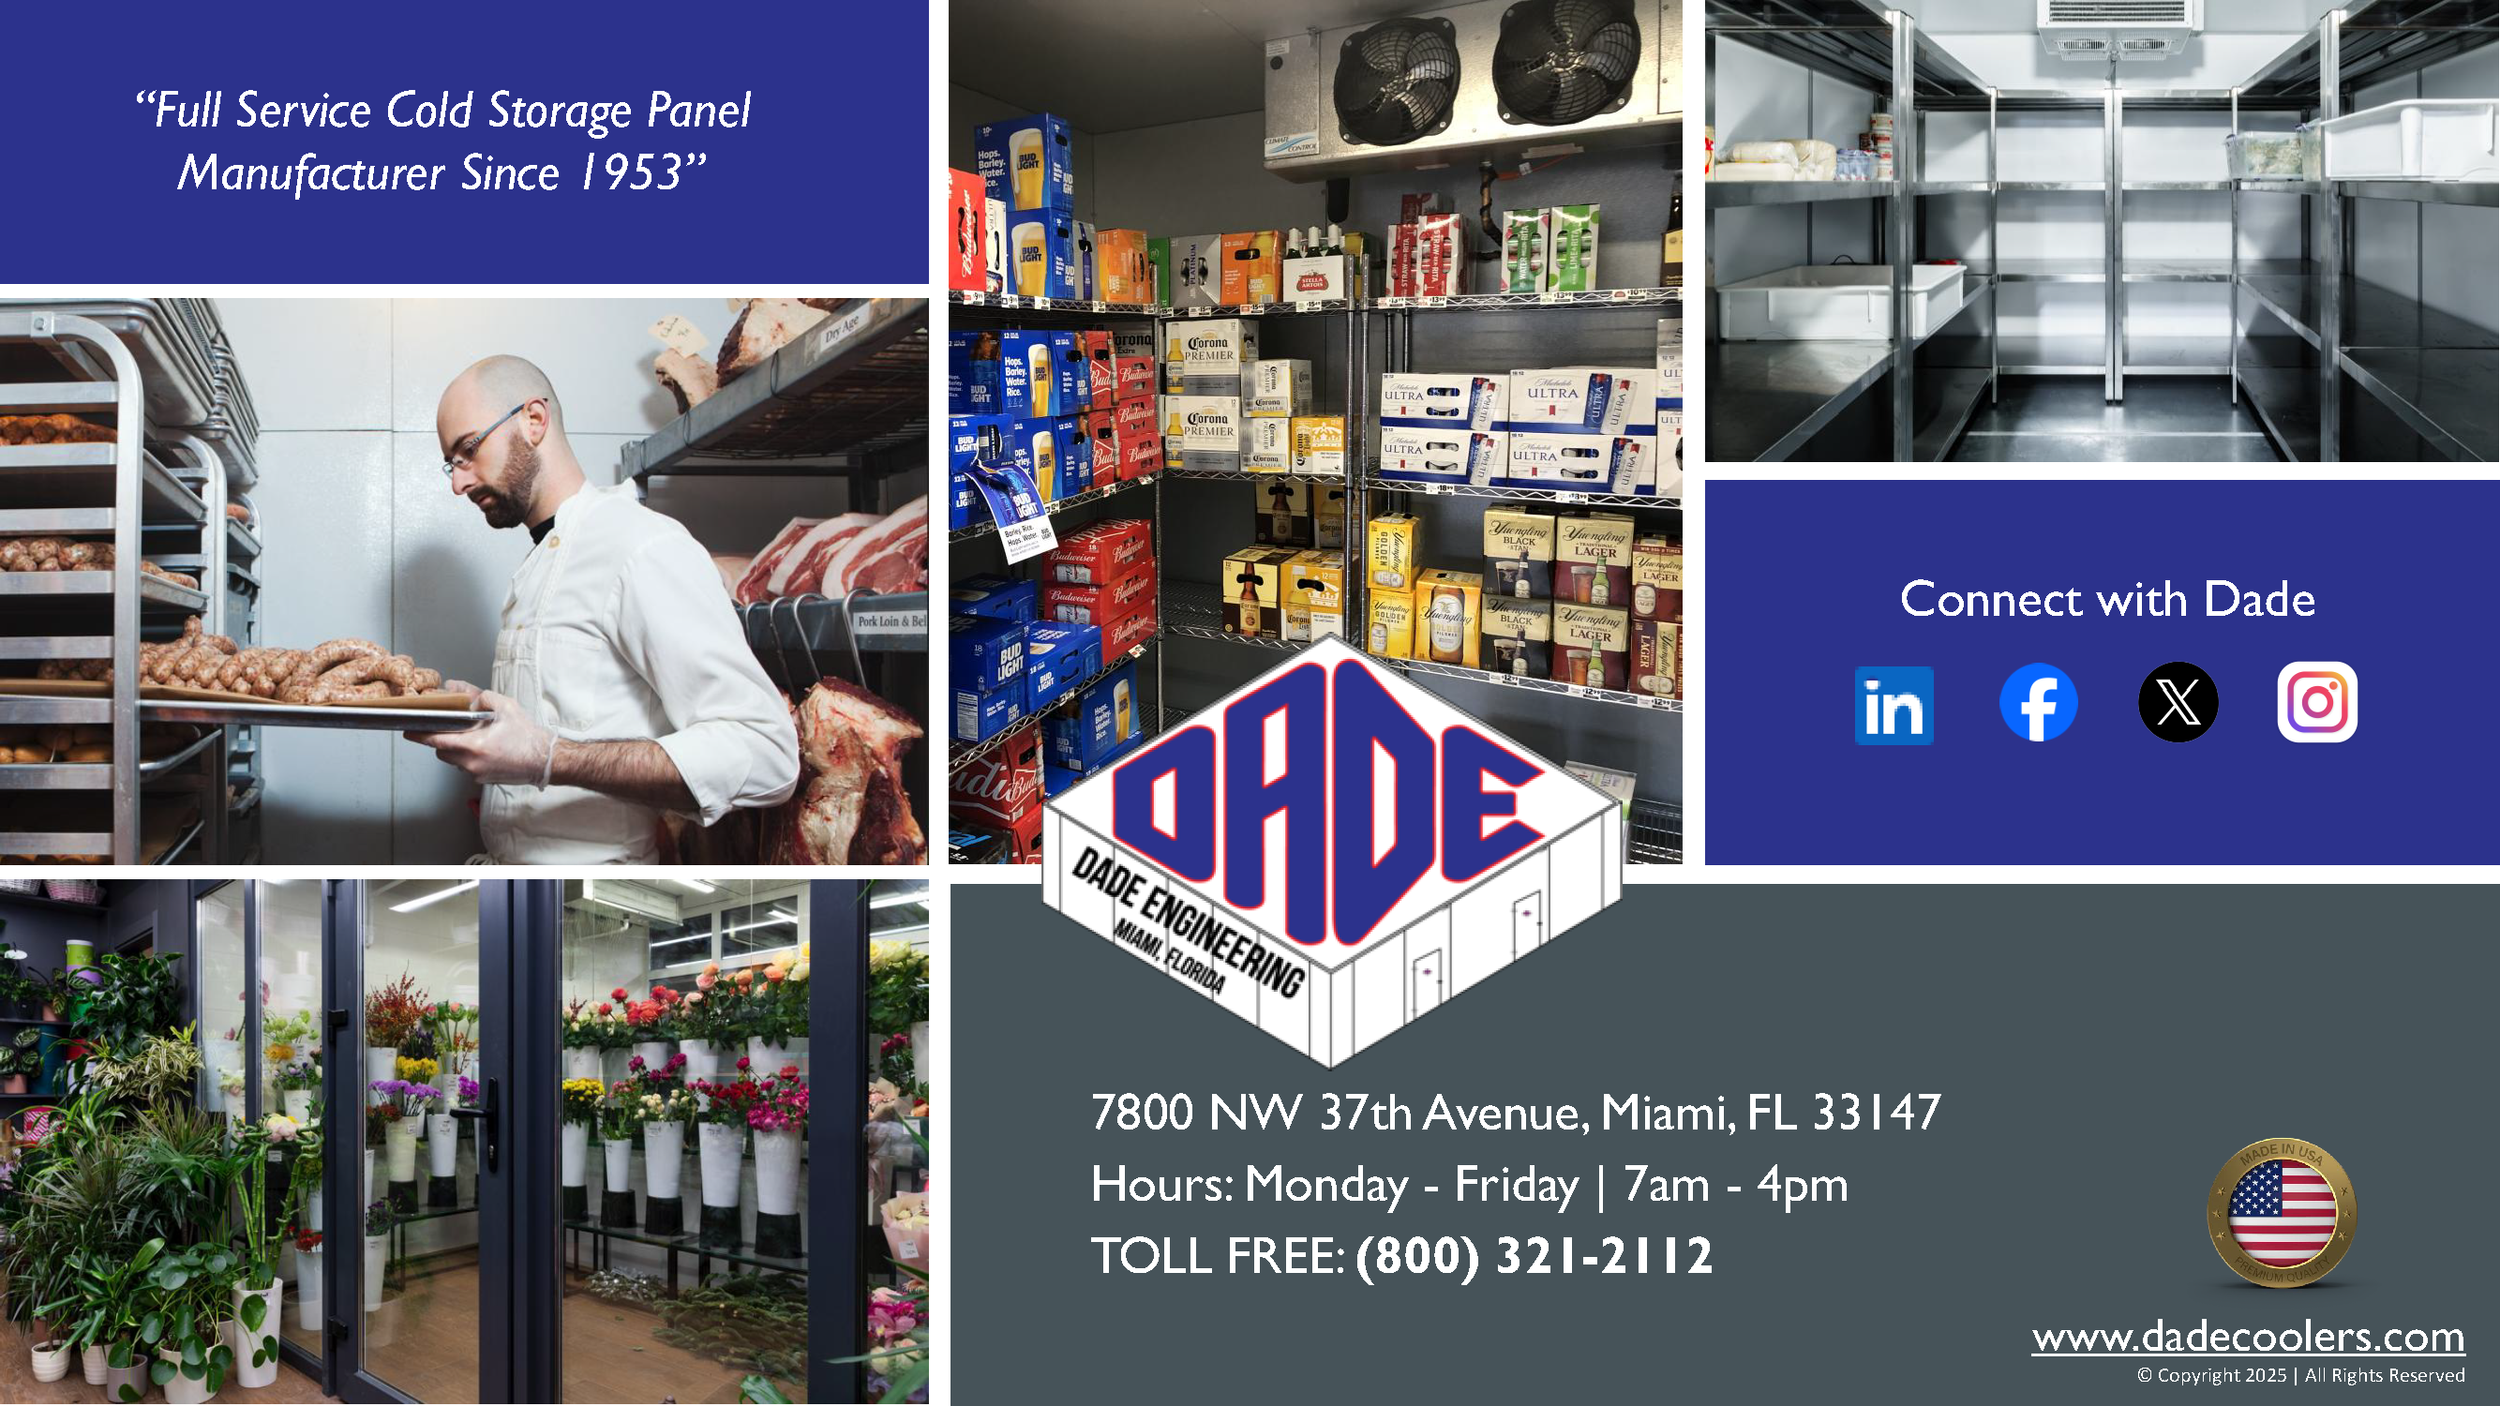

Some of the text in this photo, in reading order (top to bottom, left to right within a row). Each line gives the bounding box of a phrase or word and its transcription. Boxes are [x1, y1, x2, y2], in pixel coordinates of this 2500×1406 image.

[978, 158, 1006, 169] Barley.
[826, 316, 859, 343] Dry Age
[1188, 337, 1228, 351] Corona
[1005, 357, 1023, 367] Hops.
[1185, 351, 1234, 360] PREMIER
[1005, 367, 1027, 377] Barley.
[1270, 366, 1278, 390] Corona
[1006, 377, 1027, 387] Water.
[1006, 387, 1022, 397] Rice.
[1385, 391, 1424, 401] ULTRA
[1528, 388, 1579, 399] ULTRA
[1256, 399, 1281, 407] Corona
[1479, 394, 1492, 422] ULTRA
[1592, 386, 1604, 418] ULTRA
[1118, 407, 1155, 424] Budweiser
[1610, 393, 1627, 426] ULTRA
[1187, 412, 1228, 427] Corona
[1184, 426, 1235, 436] PREMIER
[958, 436, 974, 445] BUD
[1127, 444, 1163, 463] Budweiser
[1297, 433, 1306, 466] Corona
[1384, 445, 1423, 455] ULTRA
[1513, 451, 1558, 461] ULTRA
[1253, 455, 1279, 463] Corona
[1478, 450, 1491, 478] ULTRA
[1621, 456, 1637, 486] ULTRA
[956, 497, 976, 507] LIGHT
[959, 490, 974, 500] BUD
[1013, 493, 1031, 507] BUD
[1016, 502, 1039, 519] LIGHT
[1488, 519, 1549, 537] Yuengling
[1562, 525, 1628, 544] Yuengling
[1503, 537, 1536, 546] BLACK
[1050, 550, 1096, 562] Budweiser
[1112, 540, 1145, 564] Budweiser
[1380, 531, 1388, 567] GOLDEN
[1390, 528, 1405, 572] Yuengling
[1575, 546, 1617, 558] LAGER
[1634, 556, 1683, 570] Yuengling
[1643, 572, 1679, 582] LAGER
[1050, 590, 1096, 603] Budweiser
[1113, 579, 1149, 604] Budweiser
[1371, 600, 1411, 614] Yuengling
[1487, 598, 1545, 619] Yuengling
[859, 616, 877, 627] Pork
[880, 615, 899, 627] Loin
[901, 615, 909, 627] &
[1375, 611, 1406, 620] GOLDEN
[1420, 606, 1473, 625] Yuengling
[1500, 614, 1533, 626] BLACK
[1558, 606, 1623, 628] Yuengling
[1112, 617, 1148, 645] Budweiser
[1570, 628, 1612, 643] LAGER
[1000, 642, 1022, 666] BUD
[1640, 635, 1651, 668] LAGER
[1660, 631, 1674, 676] Yuengling
[998, 655, 1024, 682] LIGHT
[1038, 677, 1055, 692] LIGHT
[1040, 672, 1052, 684] BUD
